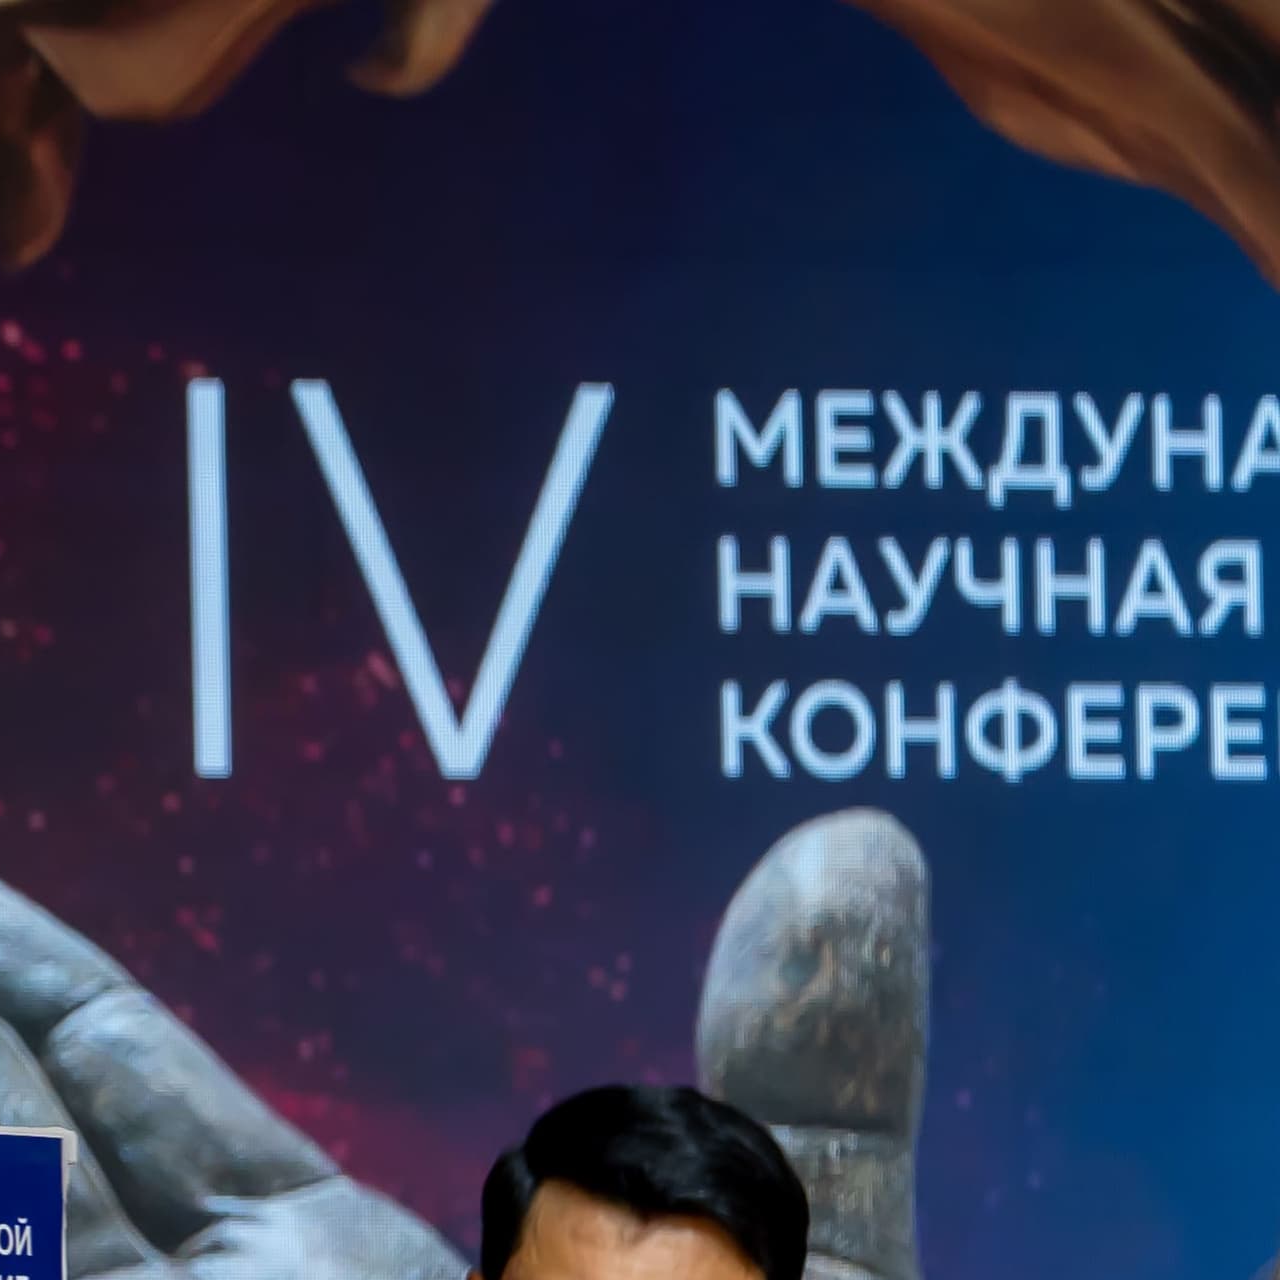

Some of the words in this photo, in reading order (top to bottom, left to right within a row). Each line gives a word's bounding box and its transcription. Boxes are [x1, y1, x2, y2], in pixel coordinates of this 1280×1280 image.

[714, 387, 1280, 509] МЕЖДУНА
[186, 377, 615, 779] IV
[717, 535, 1264, 637] НАУЧНАЯ
[720, 678, 1280, 782] КОНФЕРЕ
